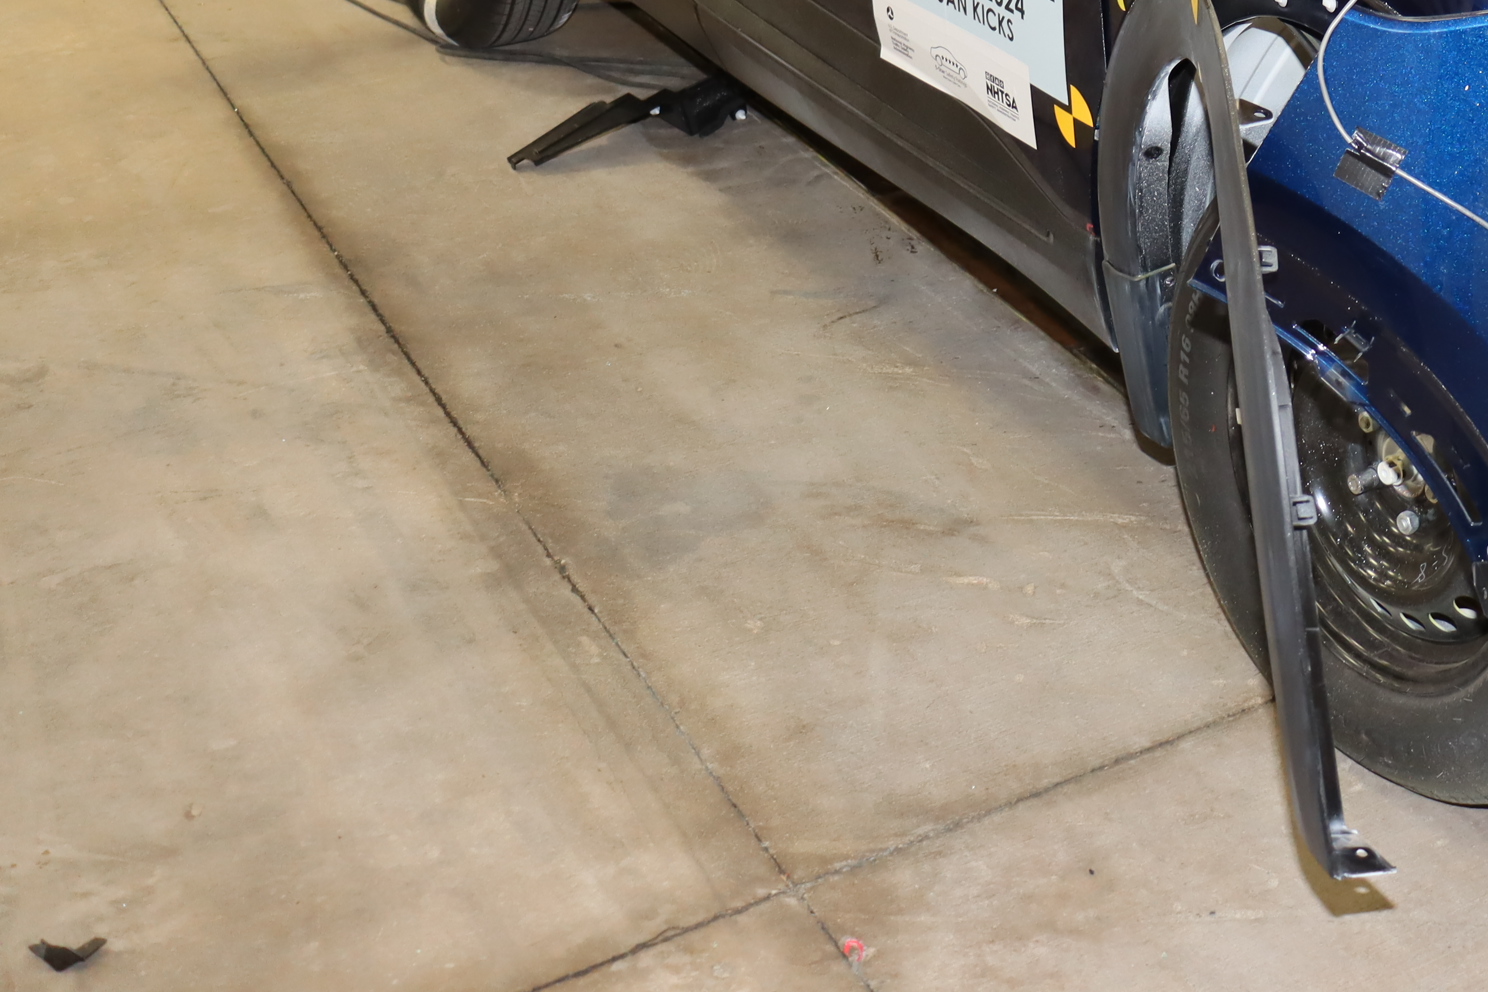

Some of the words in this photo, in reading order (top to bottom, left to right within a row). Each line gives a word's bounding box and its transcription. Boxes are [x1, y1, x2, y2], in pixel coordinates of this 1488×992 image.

[973, 0, 1015, 42] KICKS
[986, 81, 1019, 112] NHTSA
[1178, 334, 1193, 386] R16
